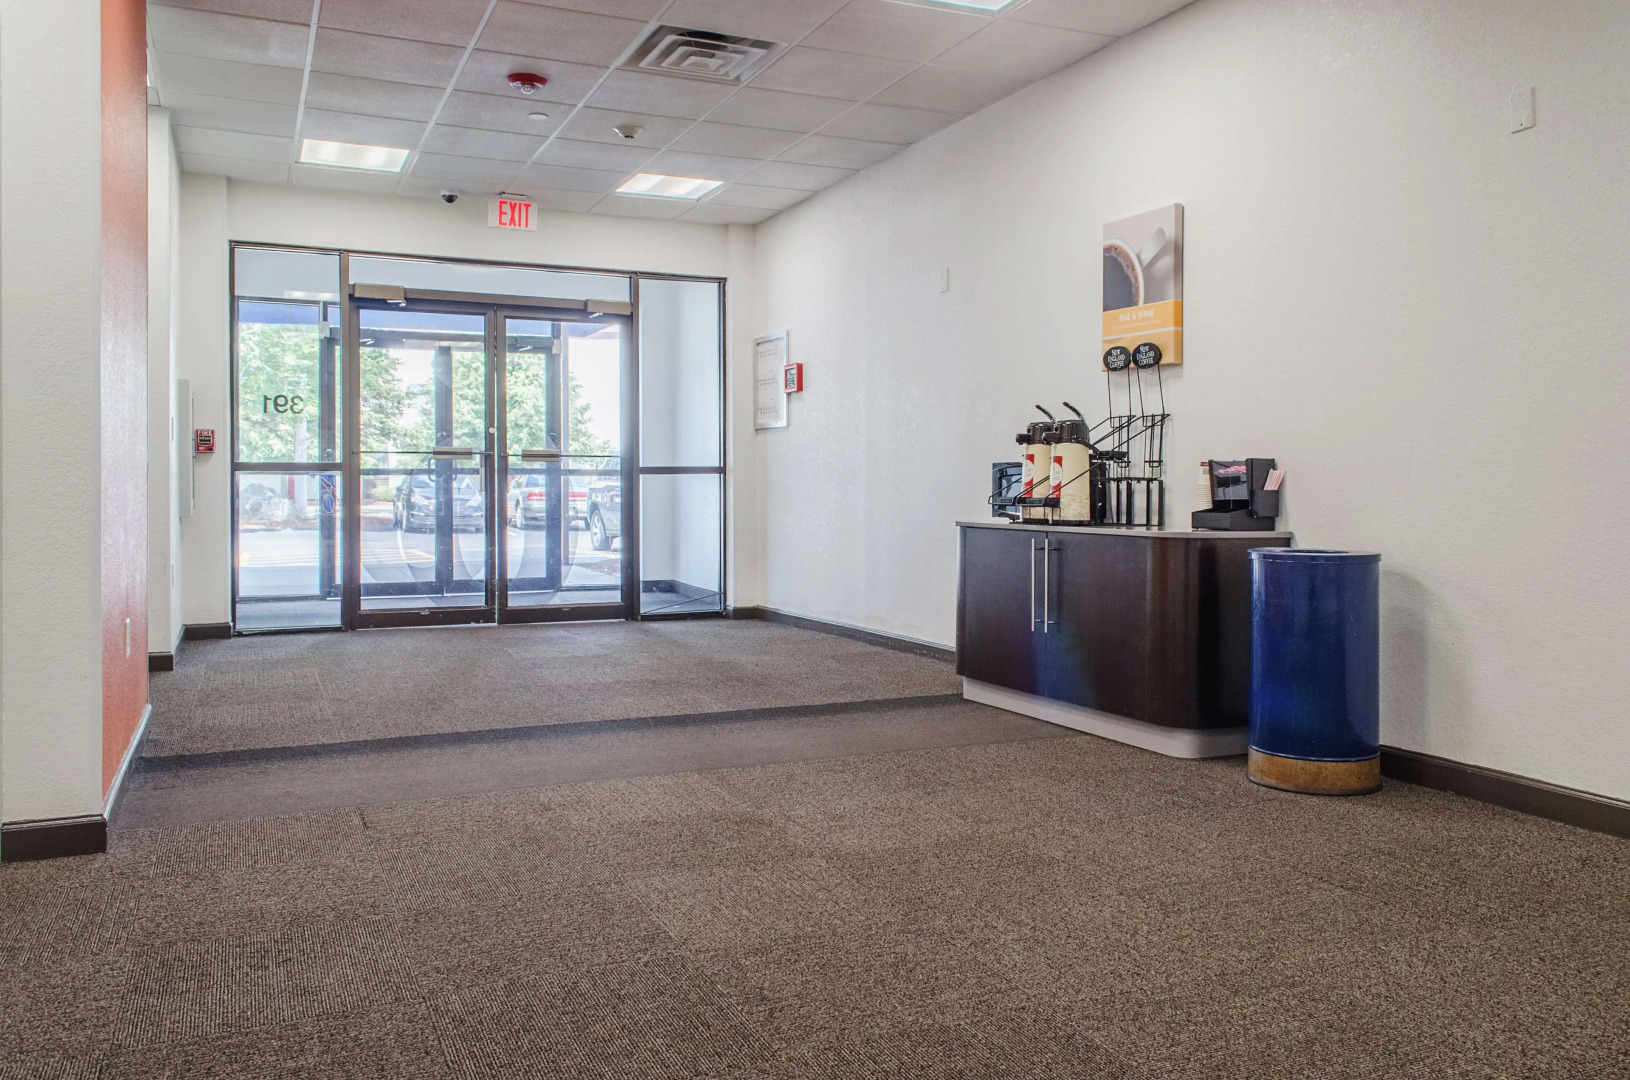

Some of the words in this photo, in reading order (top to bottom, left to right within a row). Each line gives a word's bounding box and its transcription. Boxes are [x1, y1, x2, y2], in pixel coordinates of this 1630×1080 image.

[498, 200, 532, 228] EXIT
[1119, 313, 1131, 321] RISE
[1138, 308, 1154, 318] SHINE
[1108, 354, 1126, 362] ENGLAND
[1136, 351, 1154, 360] ENGLAND
